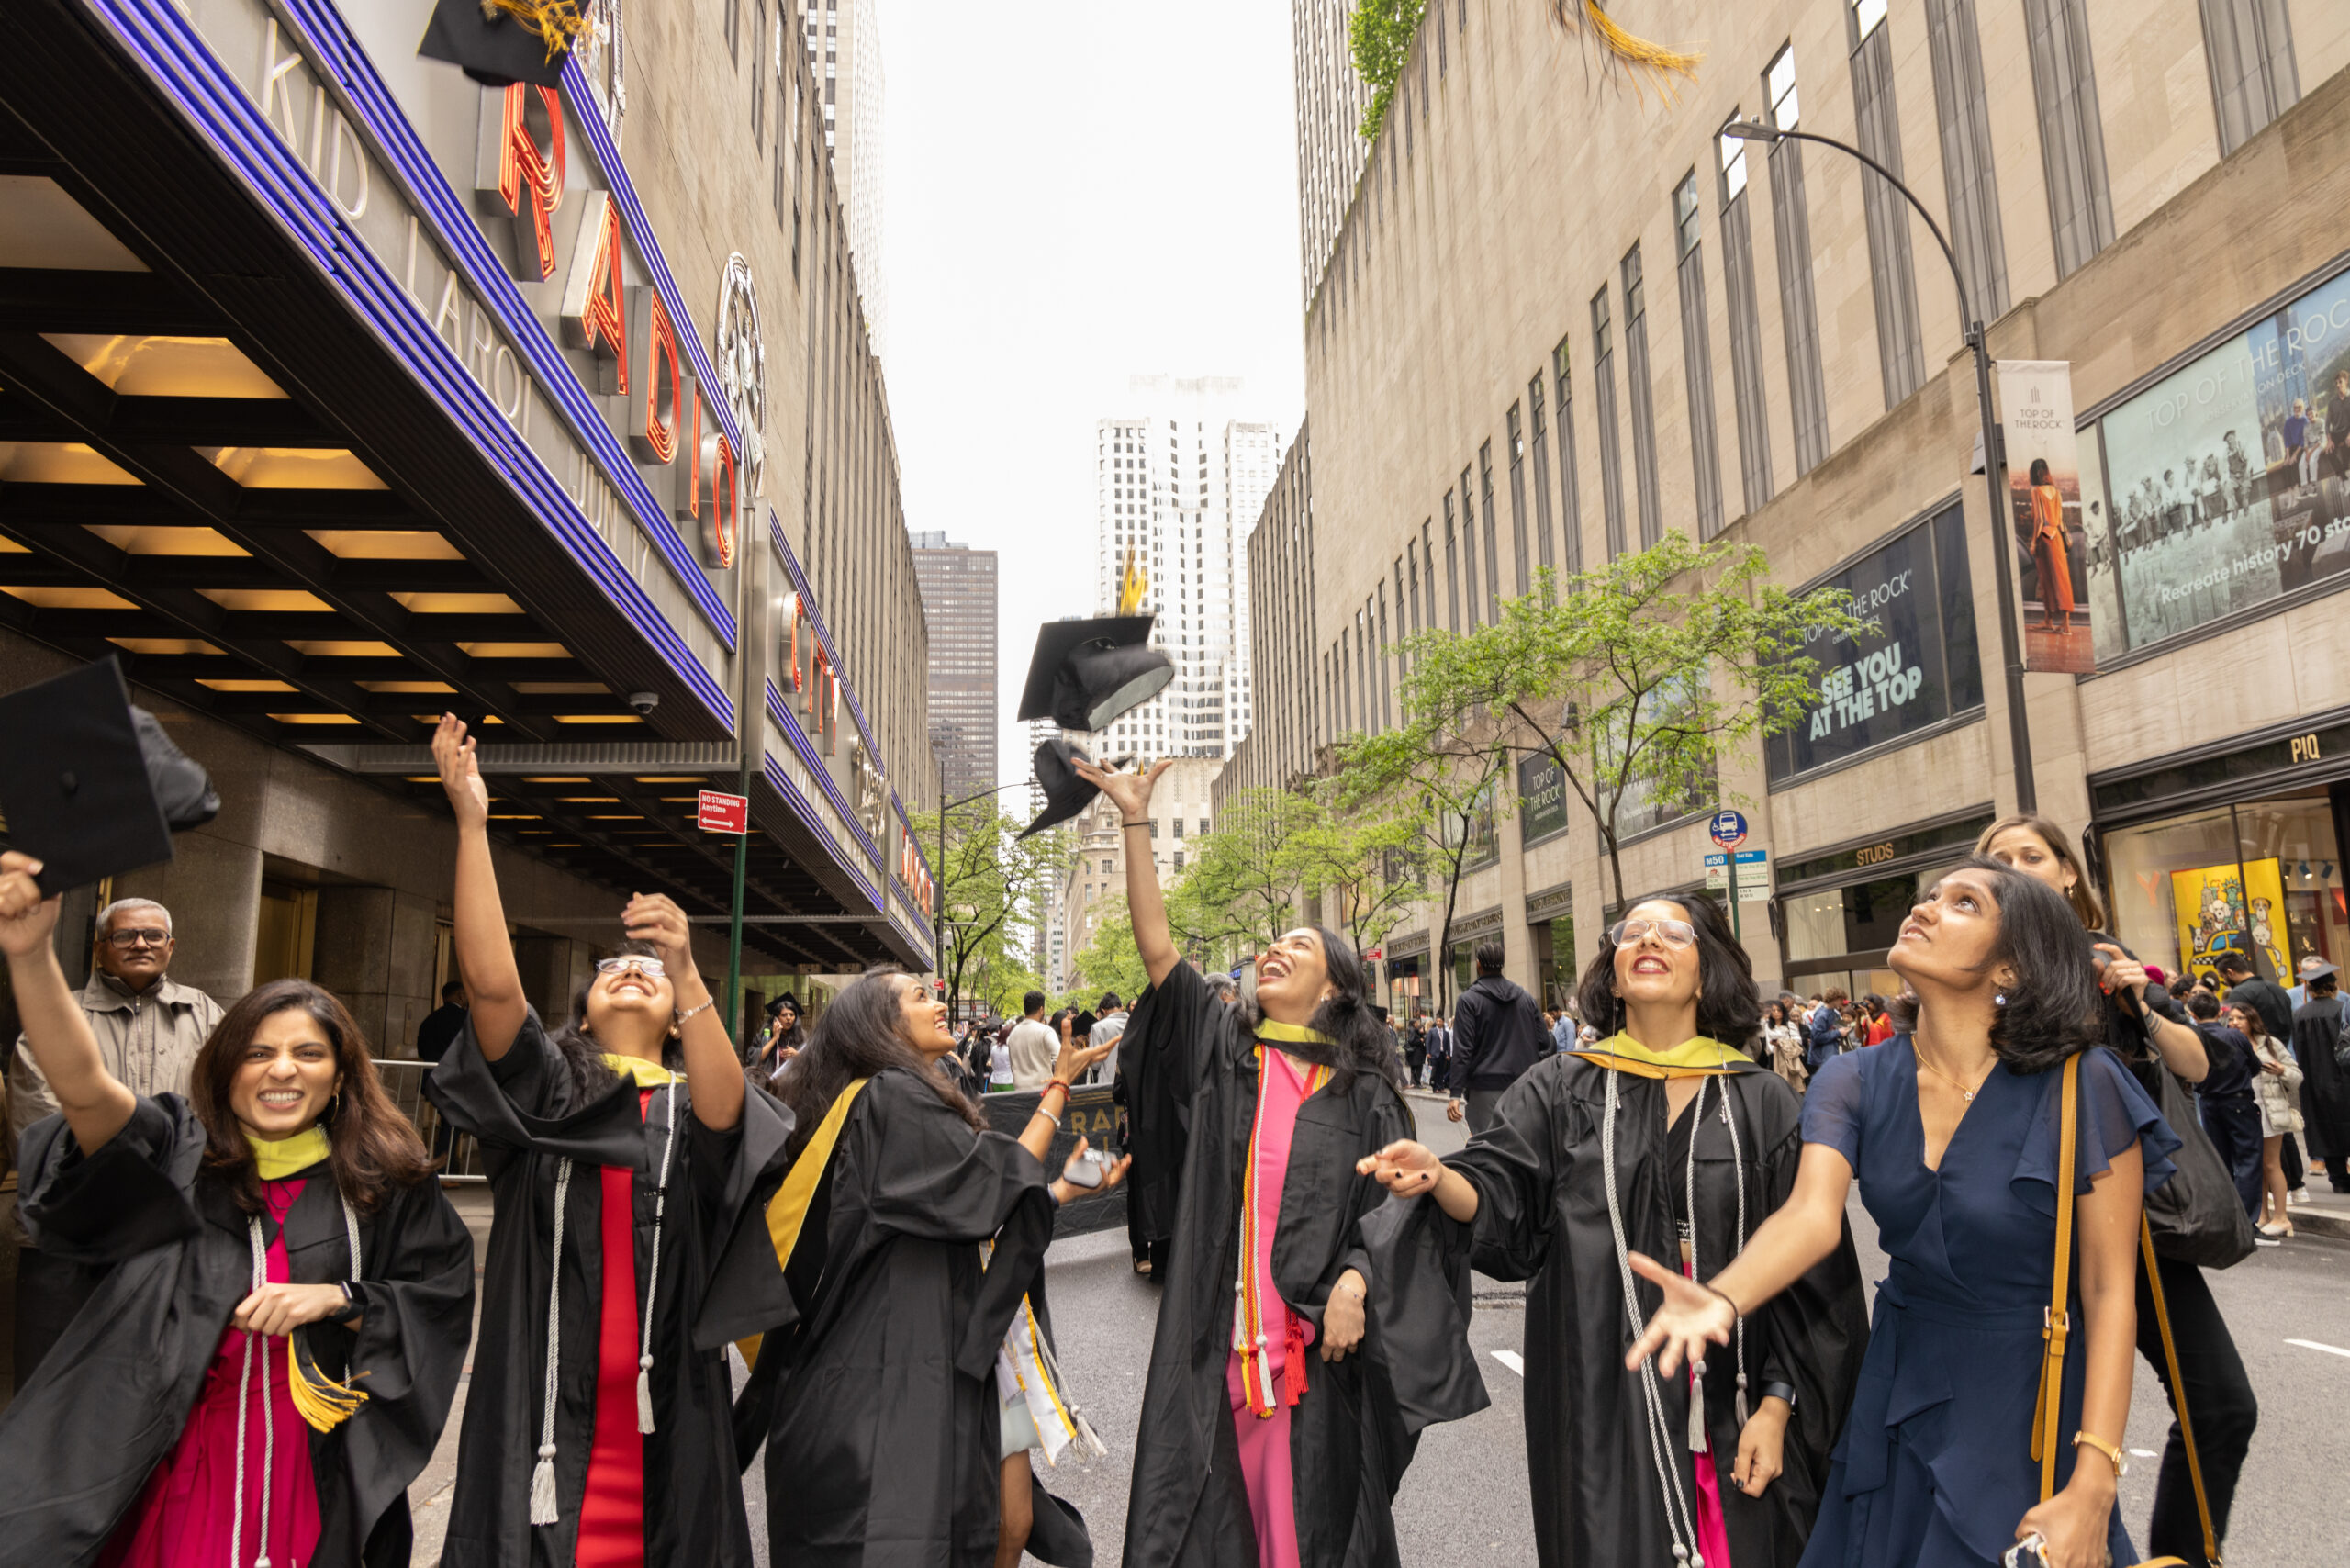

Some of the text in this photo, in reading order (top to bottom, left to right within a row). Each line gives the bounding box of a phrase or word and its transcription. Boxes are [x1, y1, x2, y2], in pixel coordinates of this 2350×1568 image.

[263, 17, 532, 441] KID LAROI
[494, 81, 735, 570] RADIO
[2020, 409, 2055, 419] TOP OF
[2145, 392, 2188, 433] TOP
[2195, 367, 2227, 405] OF
[2233, 338, 2280, 383] THE
[2161, 567, 2230, 604] Recreate
[2232, 539, 2294, 576] history
[2295, 525, 2322, 551] 70
[786, 590, 842, 756] CITY
[1809, 666, 1923, 742] AT THE TOP
[1821, 641, 1902, 706] SEE YOU
[701, 794, 740, 807] NO STANDING
[702, 802, 726, 813] Anytime
[1706, 855, 1725, 866] M50
[1856, 842, 1894, 867] STUDS
